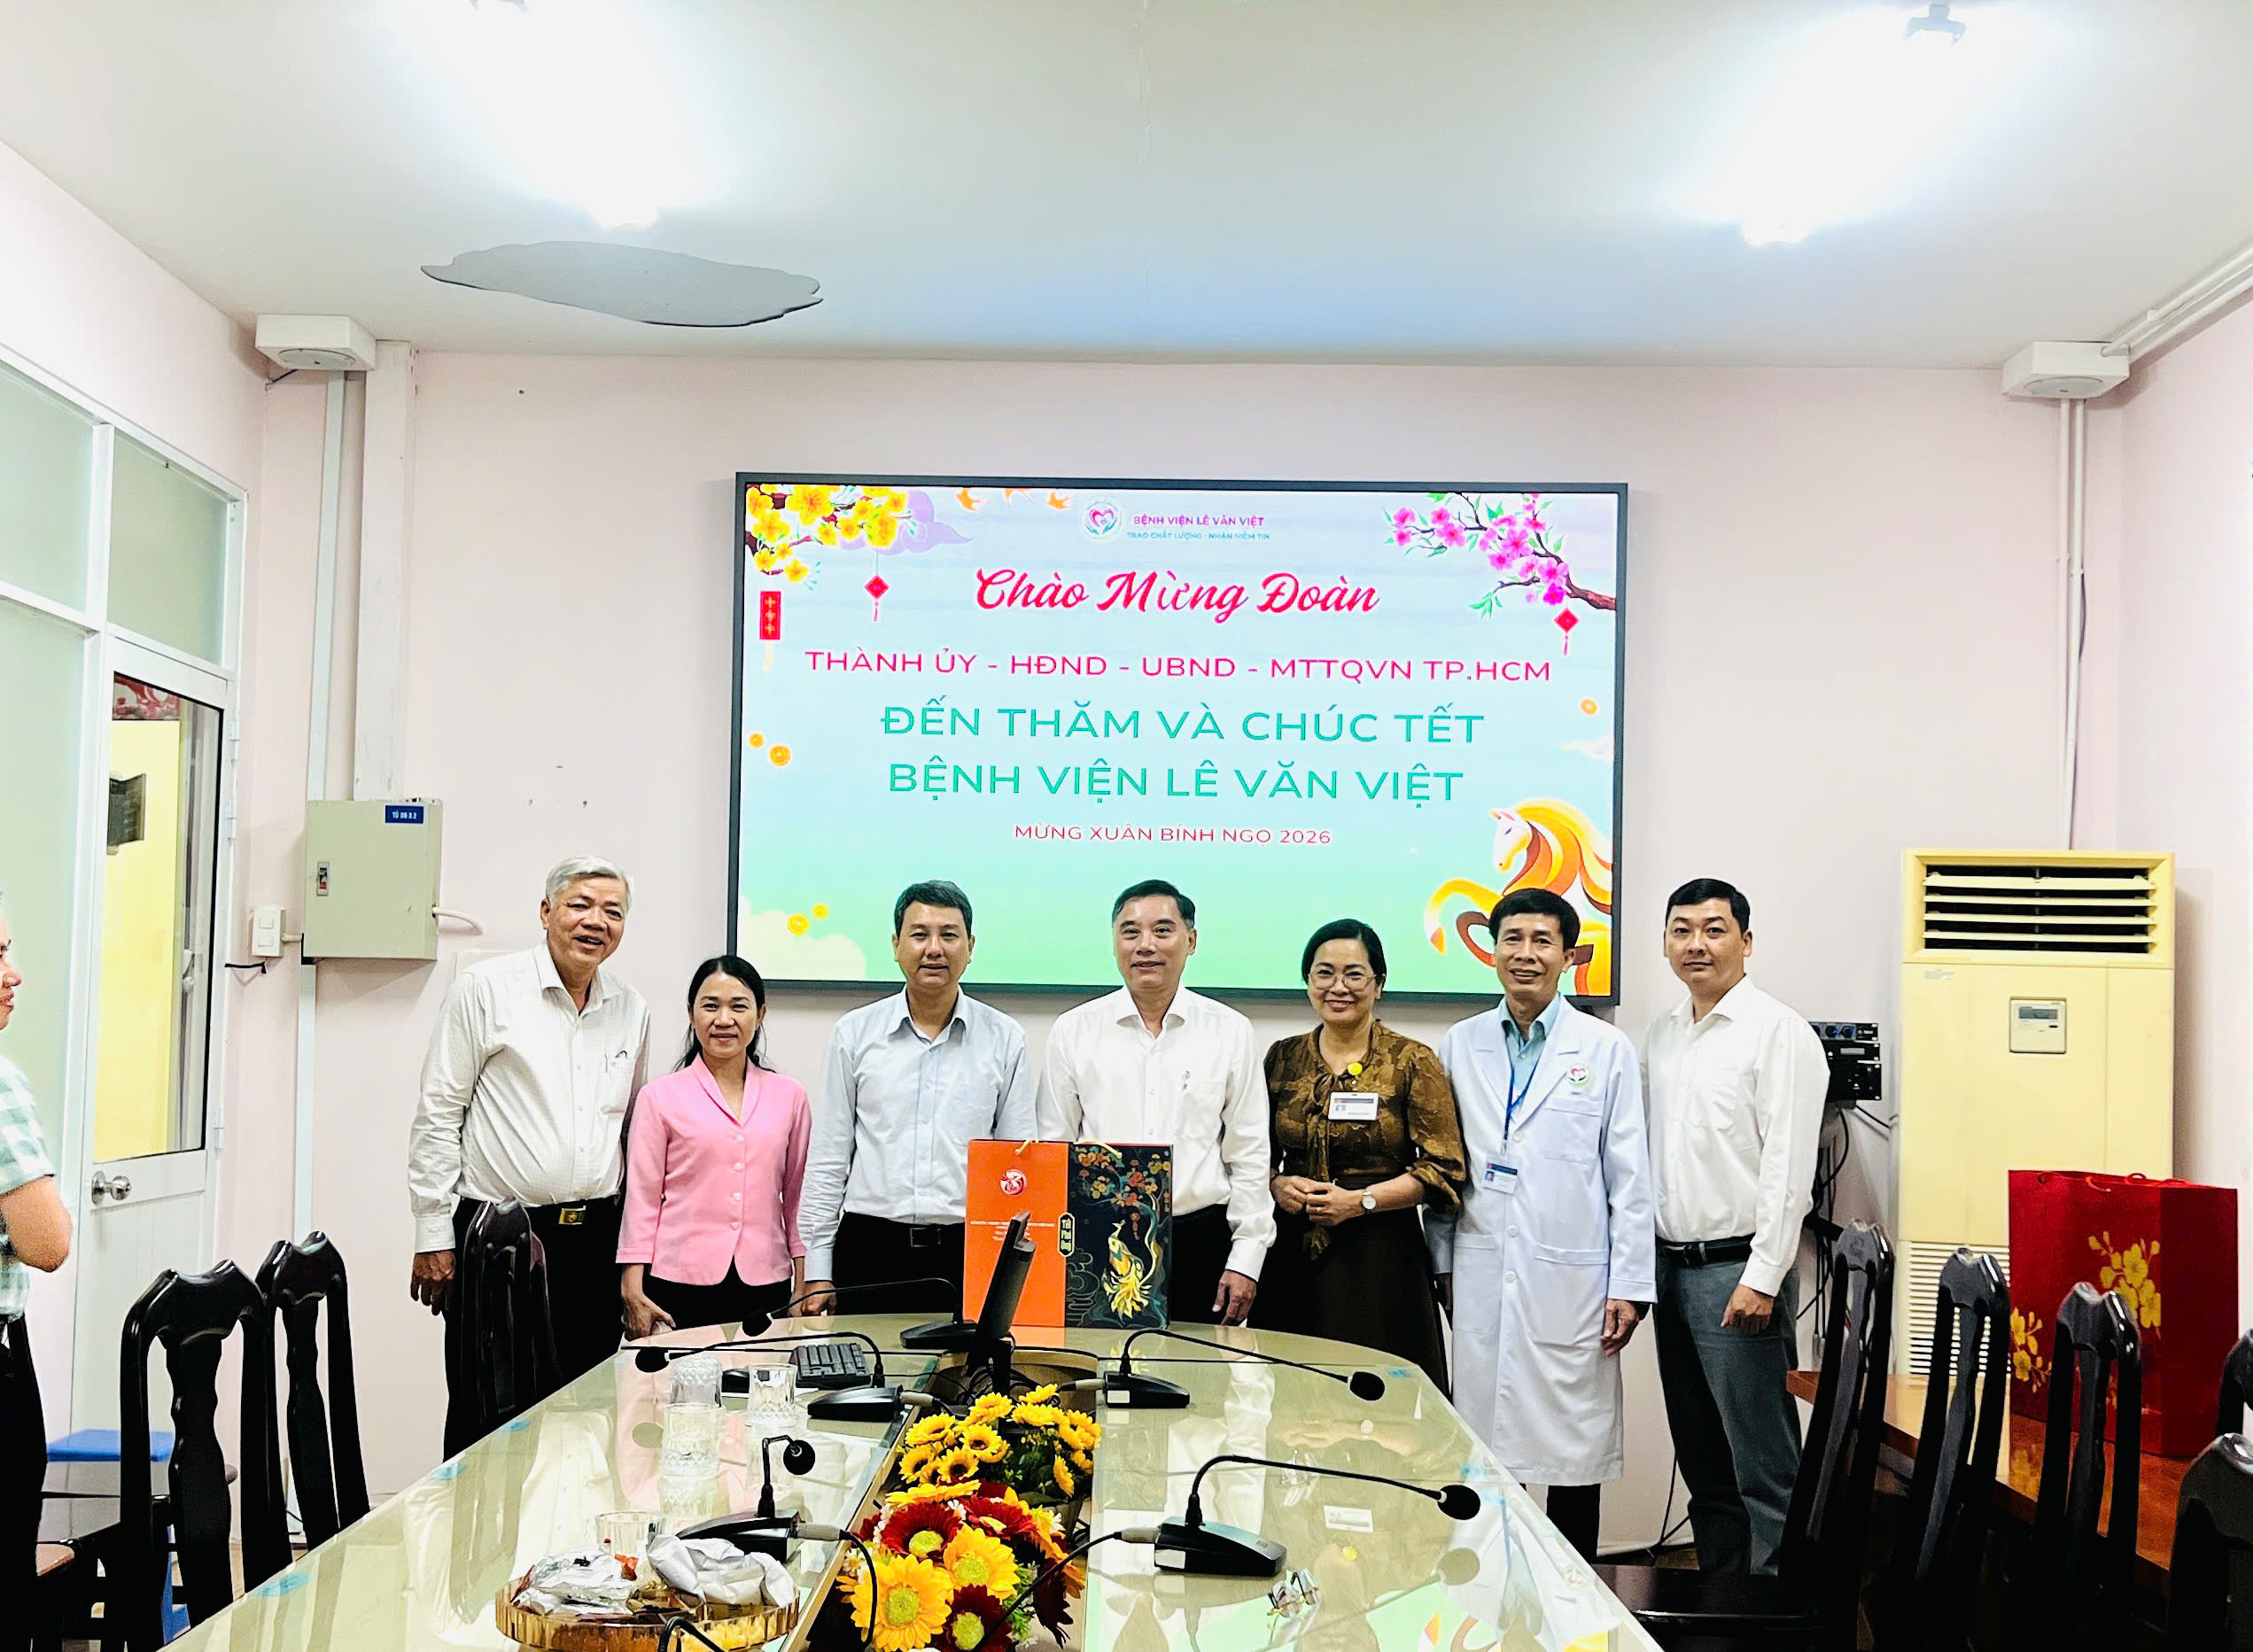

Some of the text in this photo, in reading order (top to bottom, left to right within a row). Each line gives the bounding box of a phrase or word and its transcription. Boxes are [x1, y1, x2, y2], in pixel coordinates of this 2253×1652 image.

[975, 568, 1379, 624] Chào Mừng Đoàn
[804, 647, 922, 672] THÀNH
[935, 648, 976, 673] ỦY
[1011, 655, 1107, 676] HĐND
[1142, 656, 1235, 677] UBND
[1270, 658, 1411, 684] MTTQVN
[1424, 660, 1550, 681] TP.HCM
[881, 694, 1484, 743] ĐẾN THĂM VÀ CHÚC TẾT
[890, 755, 1463, 808] BỆNH VIỆN LÊ VĂN VIỆT
[1015, 822, 1331, 847] MỪNG XUÂN BÍNH NGỌ 2026
